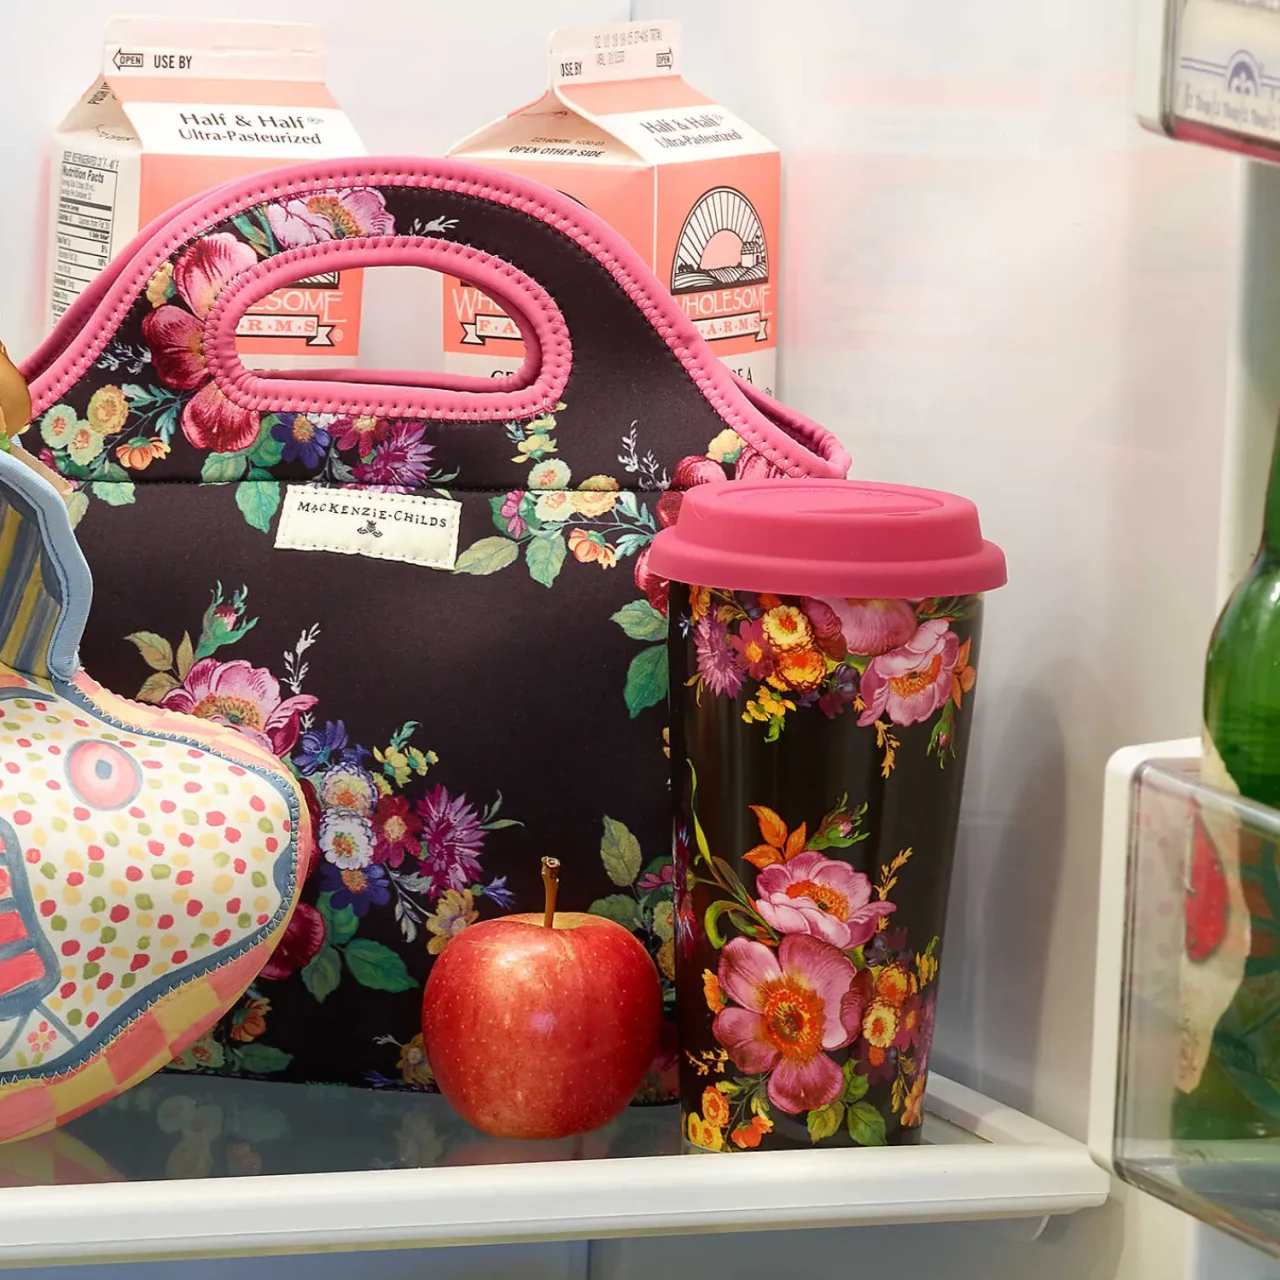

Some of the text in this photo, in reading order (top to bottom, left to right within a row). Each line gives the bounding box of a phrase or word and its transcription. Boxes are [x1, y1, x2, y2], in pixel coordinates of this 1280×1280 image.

[119, 56, 141, 65] OPEN
[154, 55, 192, 70] USE BY
[561, 62, 583, 77] USE BY
[180, 113, 305, 129] Half & Half
[639, 118, 677, 134] Half
[683, 115, 721, 129] Half
[178, 128, 322, 144] Ultra-Pasteurized
[654, 128, 743, 148] Ultra-Pasteurized
[509, 145, 605, 158] OPEN OTHER SIDE
[87, 169, 105, 184] Facts
